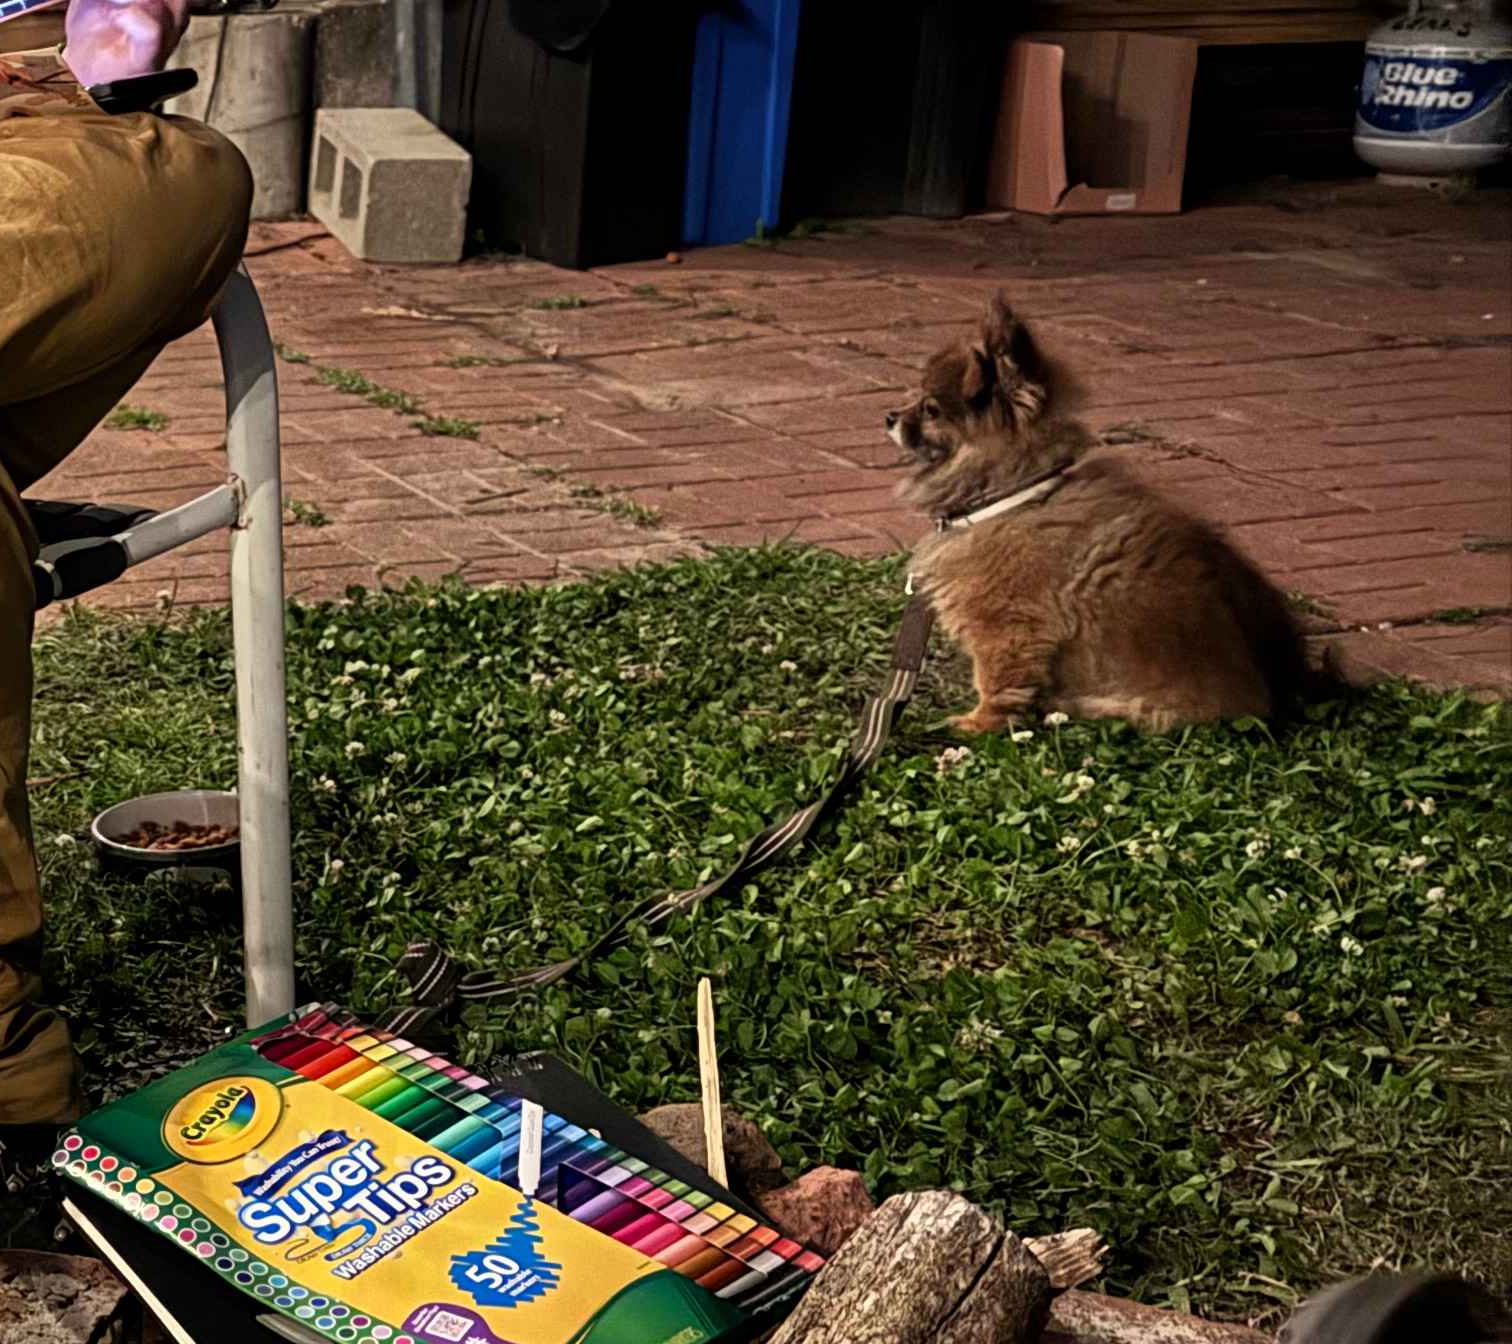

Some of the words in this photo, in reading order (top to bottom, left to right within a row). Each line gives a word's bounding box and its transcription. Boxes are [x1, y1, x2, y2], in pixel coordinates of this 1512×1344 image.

[1374, 84, 1474, 111] Rhino
[1384, 62, 1459, 86] Blue
[180, 1086, 245, 1140] Crayola
[241, 1140, 384, 1244] Super
[342, 1156, 455, 1226] Tips
[333, 1222, 415, 1280] Washable
[407, 1184, 479, 1233] Markers
[464, 1254, 520, 1289] 50
